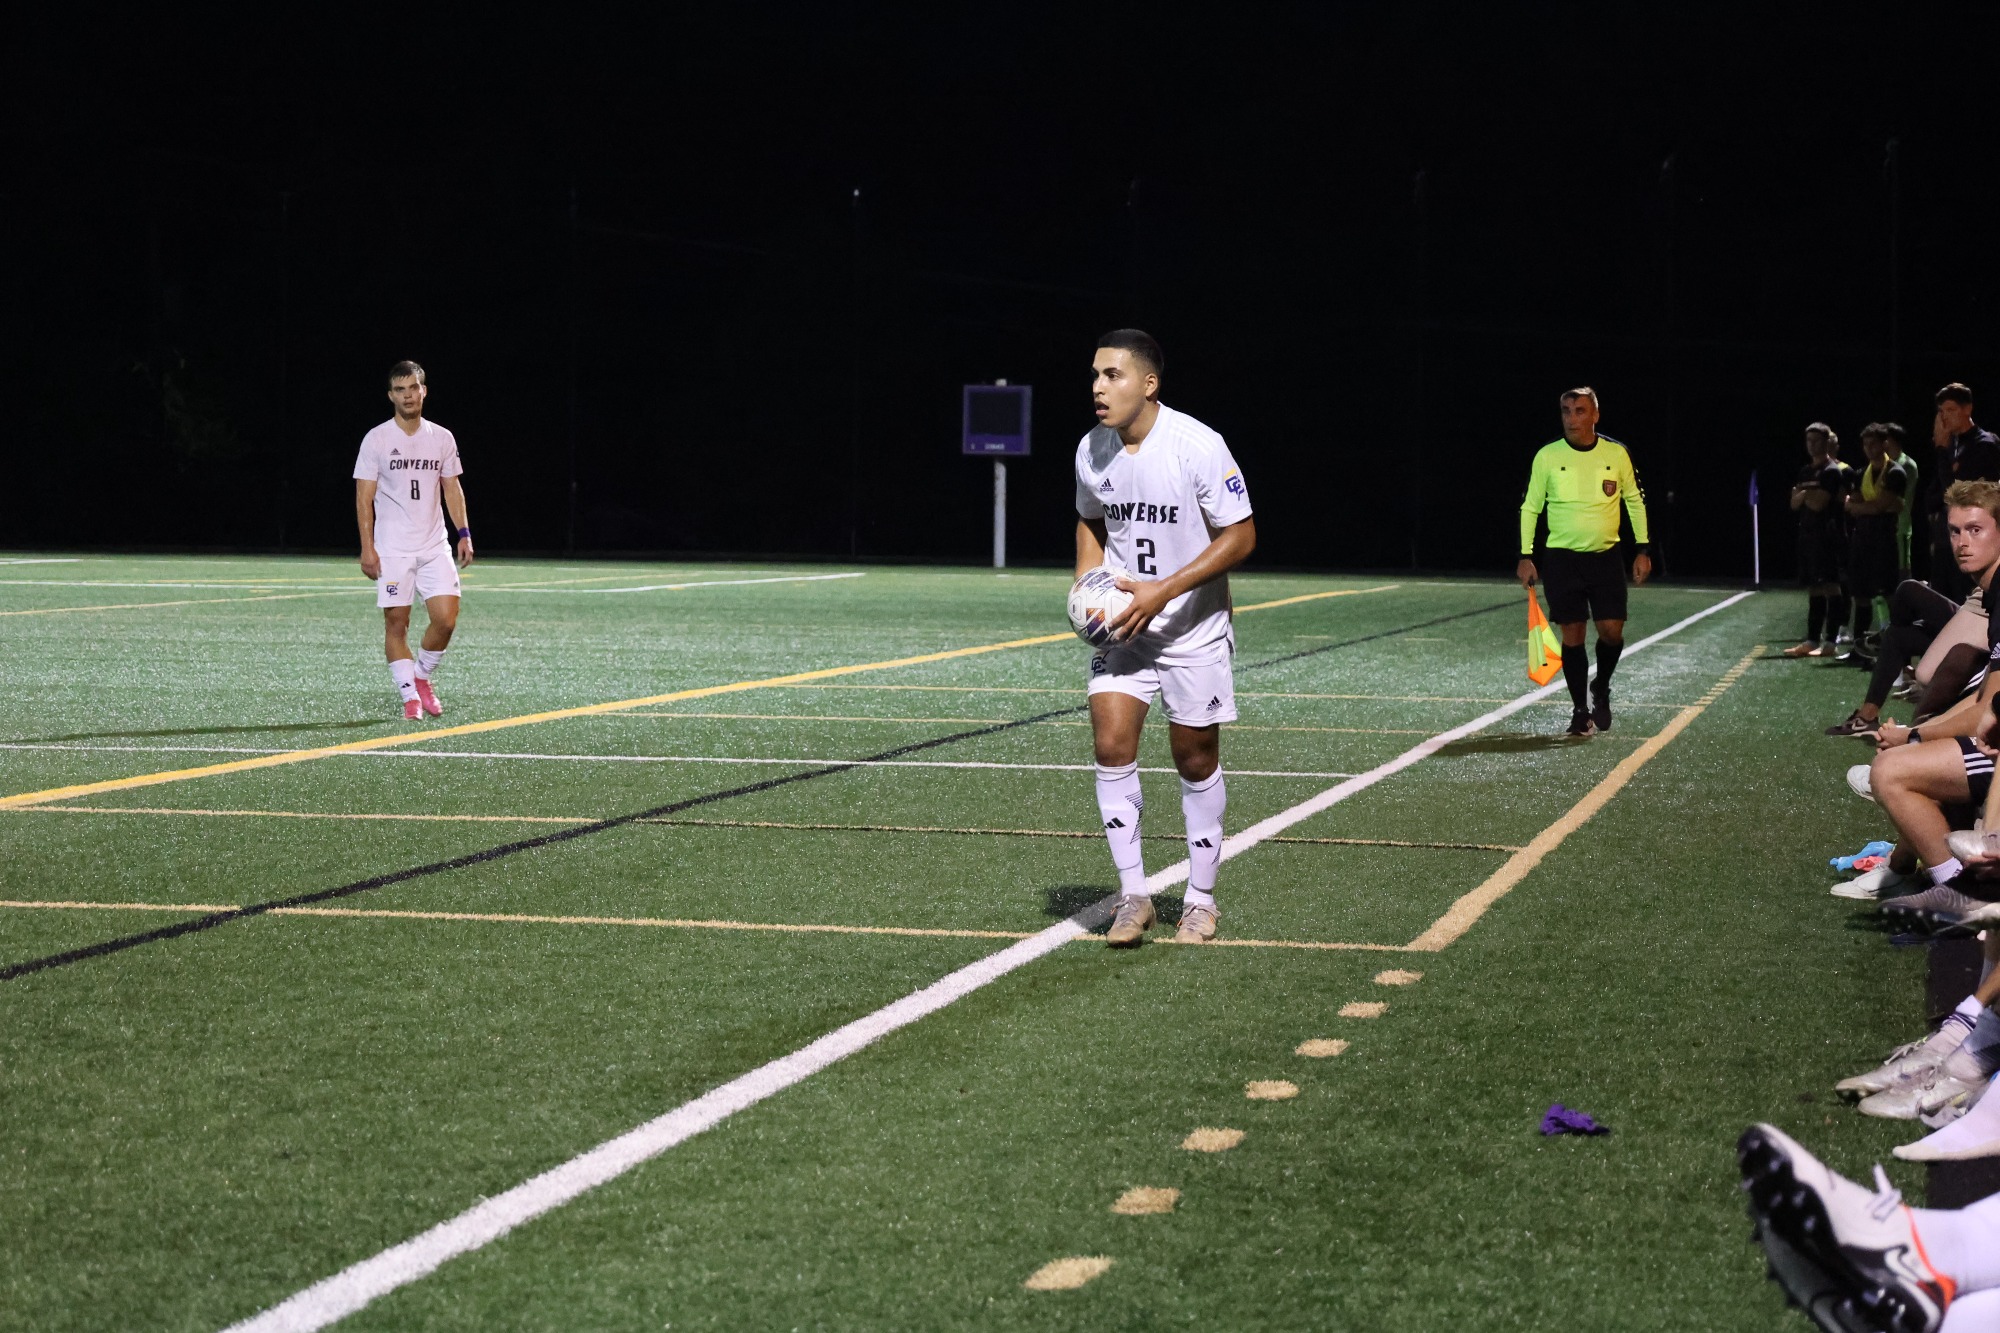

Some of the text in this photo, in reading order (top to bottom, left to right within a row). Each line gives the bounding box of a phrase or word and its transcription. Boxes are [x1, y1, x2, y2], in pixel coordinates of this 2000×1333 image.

[390, 458, 440, 471] CONVERSE
[411, 479, 420, 500] 8
[1102, 502, 1179, 524] CONVERSE
[1135, 538, 1157, 576] 2
